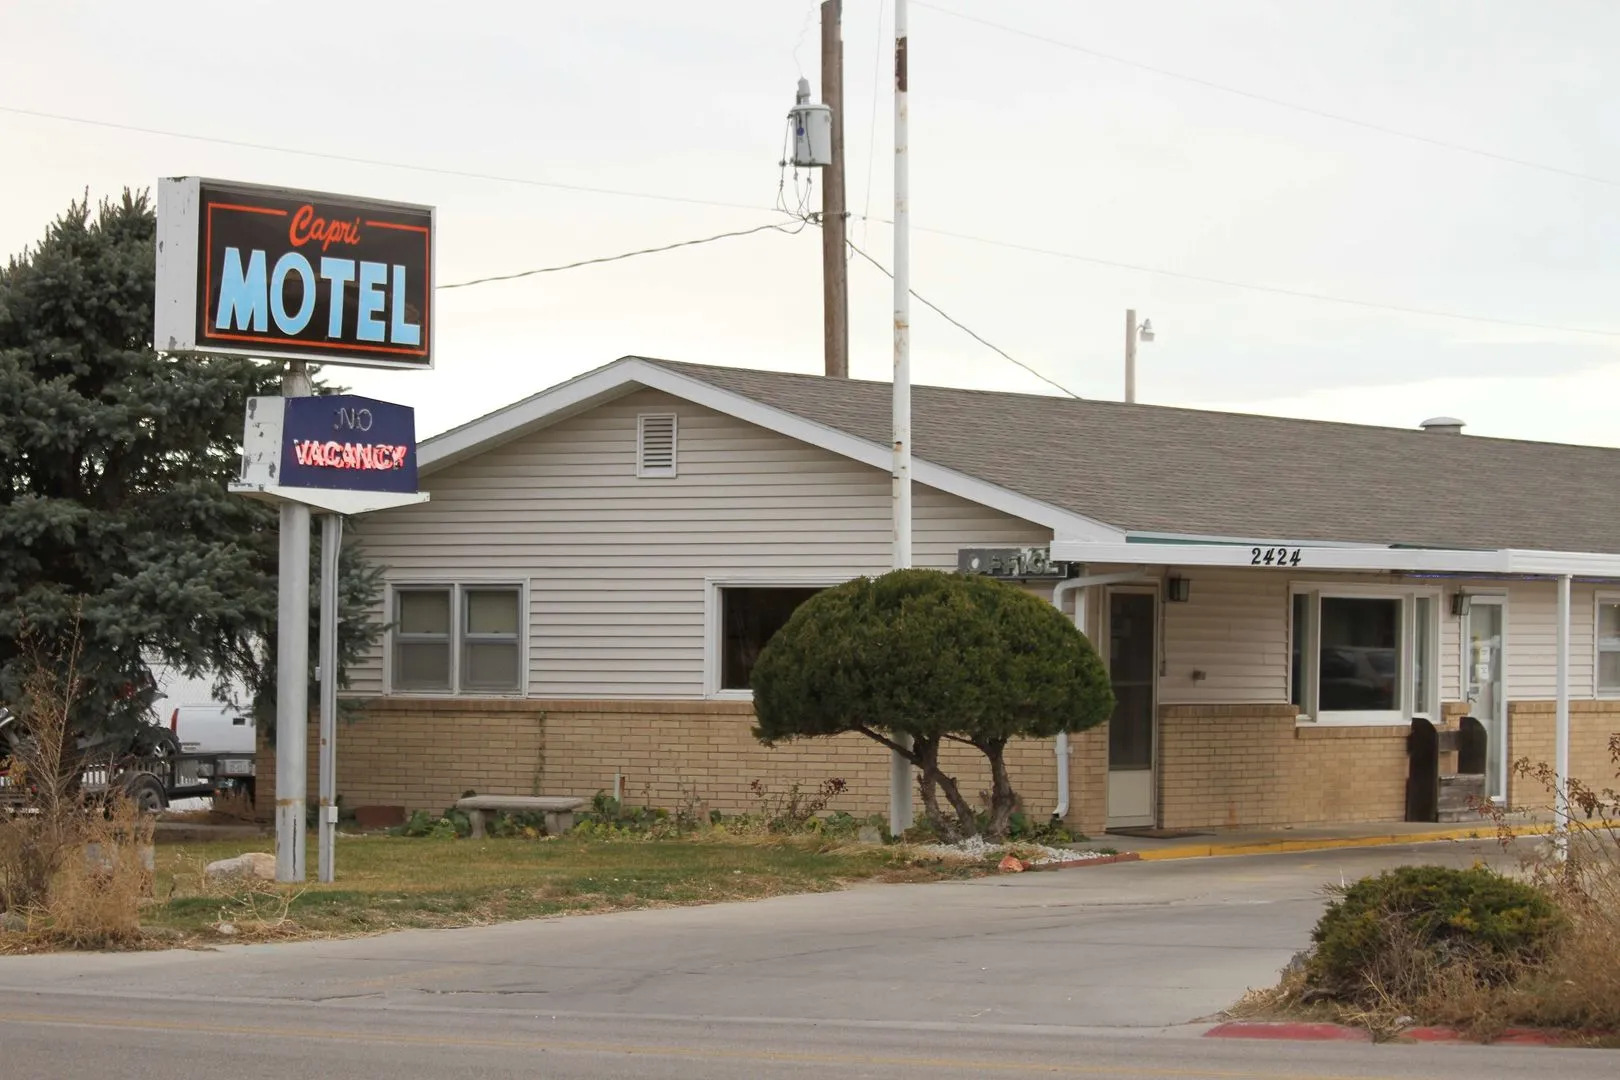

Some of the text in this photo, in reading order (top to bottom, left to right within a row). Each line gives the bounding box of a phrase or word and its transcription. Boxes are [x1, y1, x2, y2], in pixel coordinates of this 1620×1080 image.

[289, 205, 360, 251] Capri
[215, 246, 421, 345] MOTEL
[338, 407, 373, 431] NO
[293, 439, 407, 470] VACANCY
[1251, 547, 1302, 566] 2424
